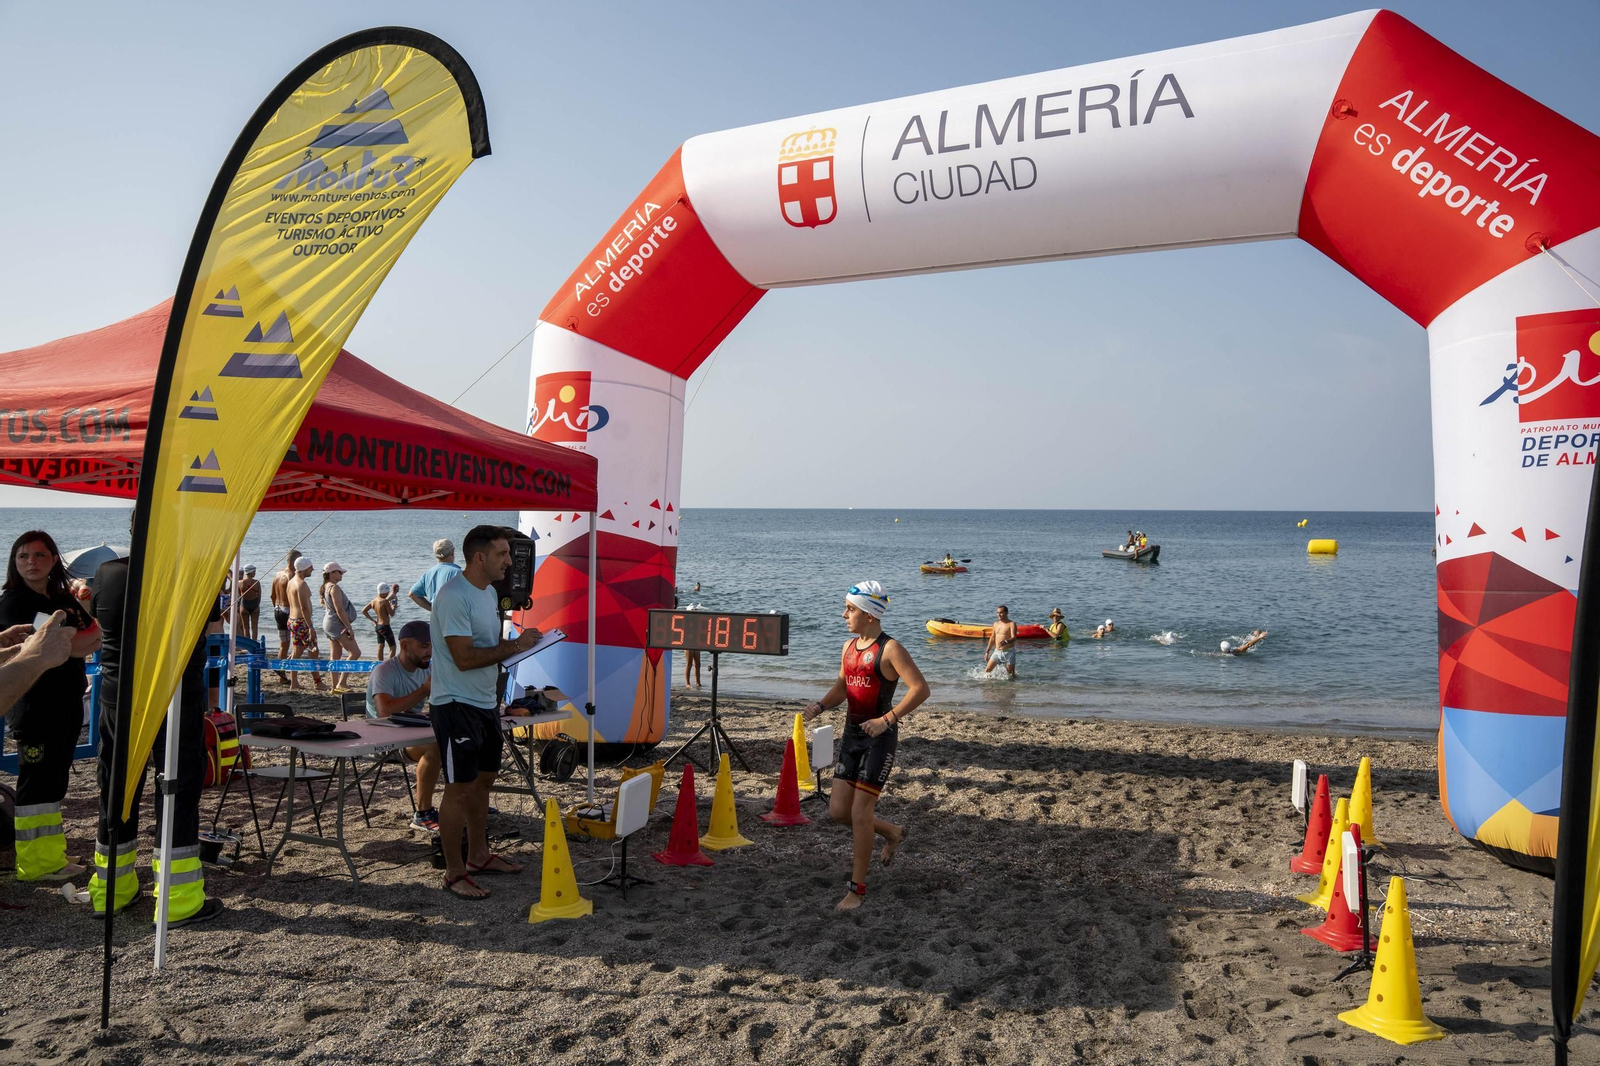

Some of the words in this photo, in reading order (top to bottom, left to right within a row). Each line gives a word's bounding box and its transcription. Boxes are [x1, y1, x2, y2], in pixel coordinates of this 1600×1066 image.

[891, 69, 1195, 161] ALMERÍA
[1378, 89, 1549, 206] ALMERÍA
[271, 187, 416, 203] www.montureventos.com
[893, 156, 1038, 205] CIUDAD
[1353, 123, 1391, 156] es
[1391, 146, 1515, 239] deporte
[264, 212, 324, 225] EVENTOS
[326, 206, 407, 224] DEPORTIVOS
[277, 228, 336, 240] TURISMO
[292, 242, 358, 256] OUTDOOR
[575, 201, 662, 302] ALMERÍA
[586, 292, 610, 317] es
[608, 215, 678, 293] deporte
[1520, 424, 1579, 434] PATRONATO
[307, 428, 572, 498] MONTUREVENTOS.COM
[1521, 454, 1549, 468] DE
